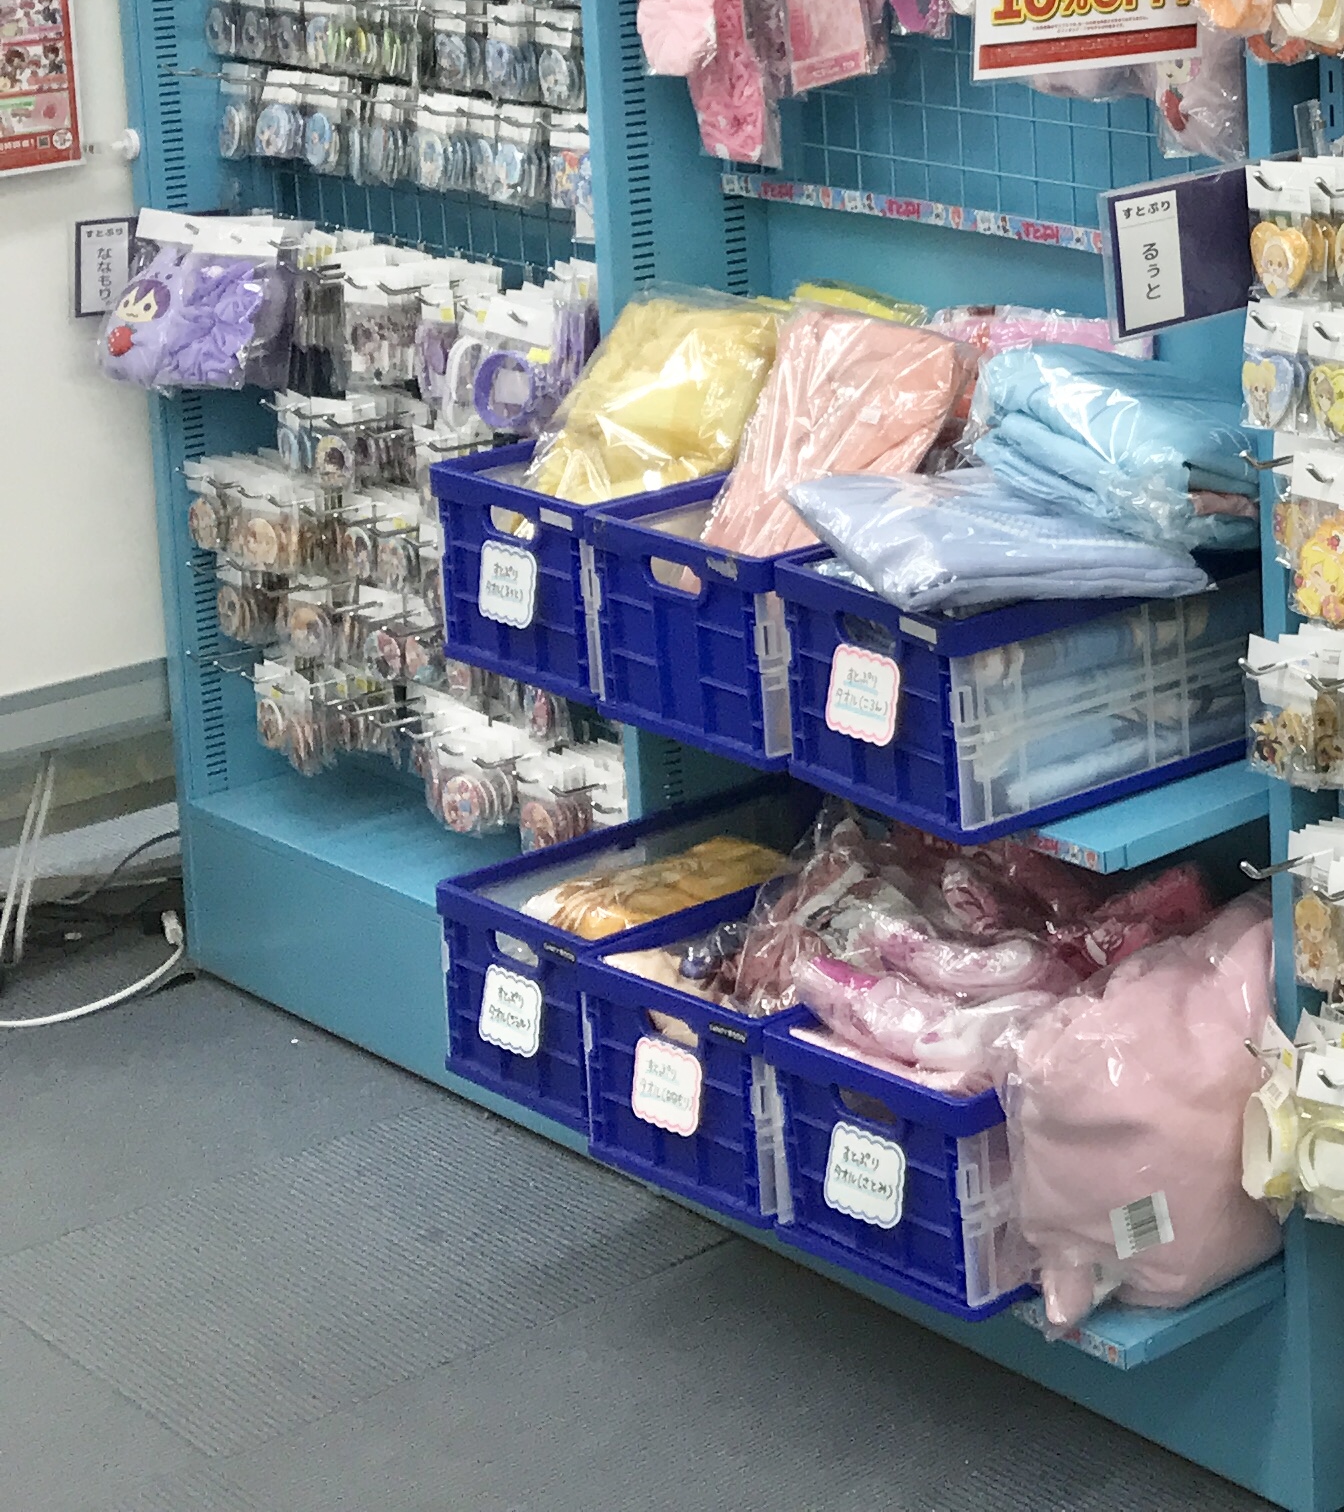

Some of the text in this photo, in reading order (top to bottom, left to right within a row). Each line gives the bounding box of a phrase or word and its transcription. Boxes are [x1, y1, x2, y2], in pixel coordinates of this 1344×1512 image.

[1122, 199, 1171, 220] すとぷり
[85, 228, 124, 239] すとぷり
[1142, 242, 1161, 300] るうと
[846, 667, 878, 687] すとぷり
[843, 1145, 880, 1172] すとぷり
